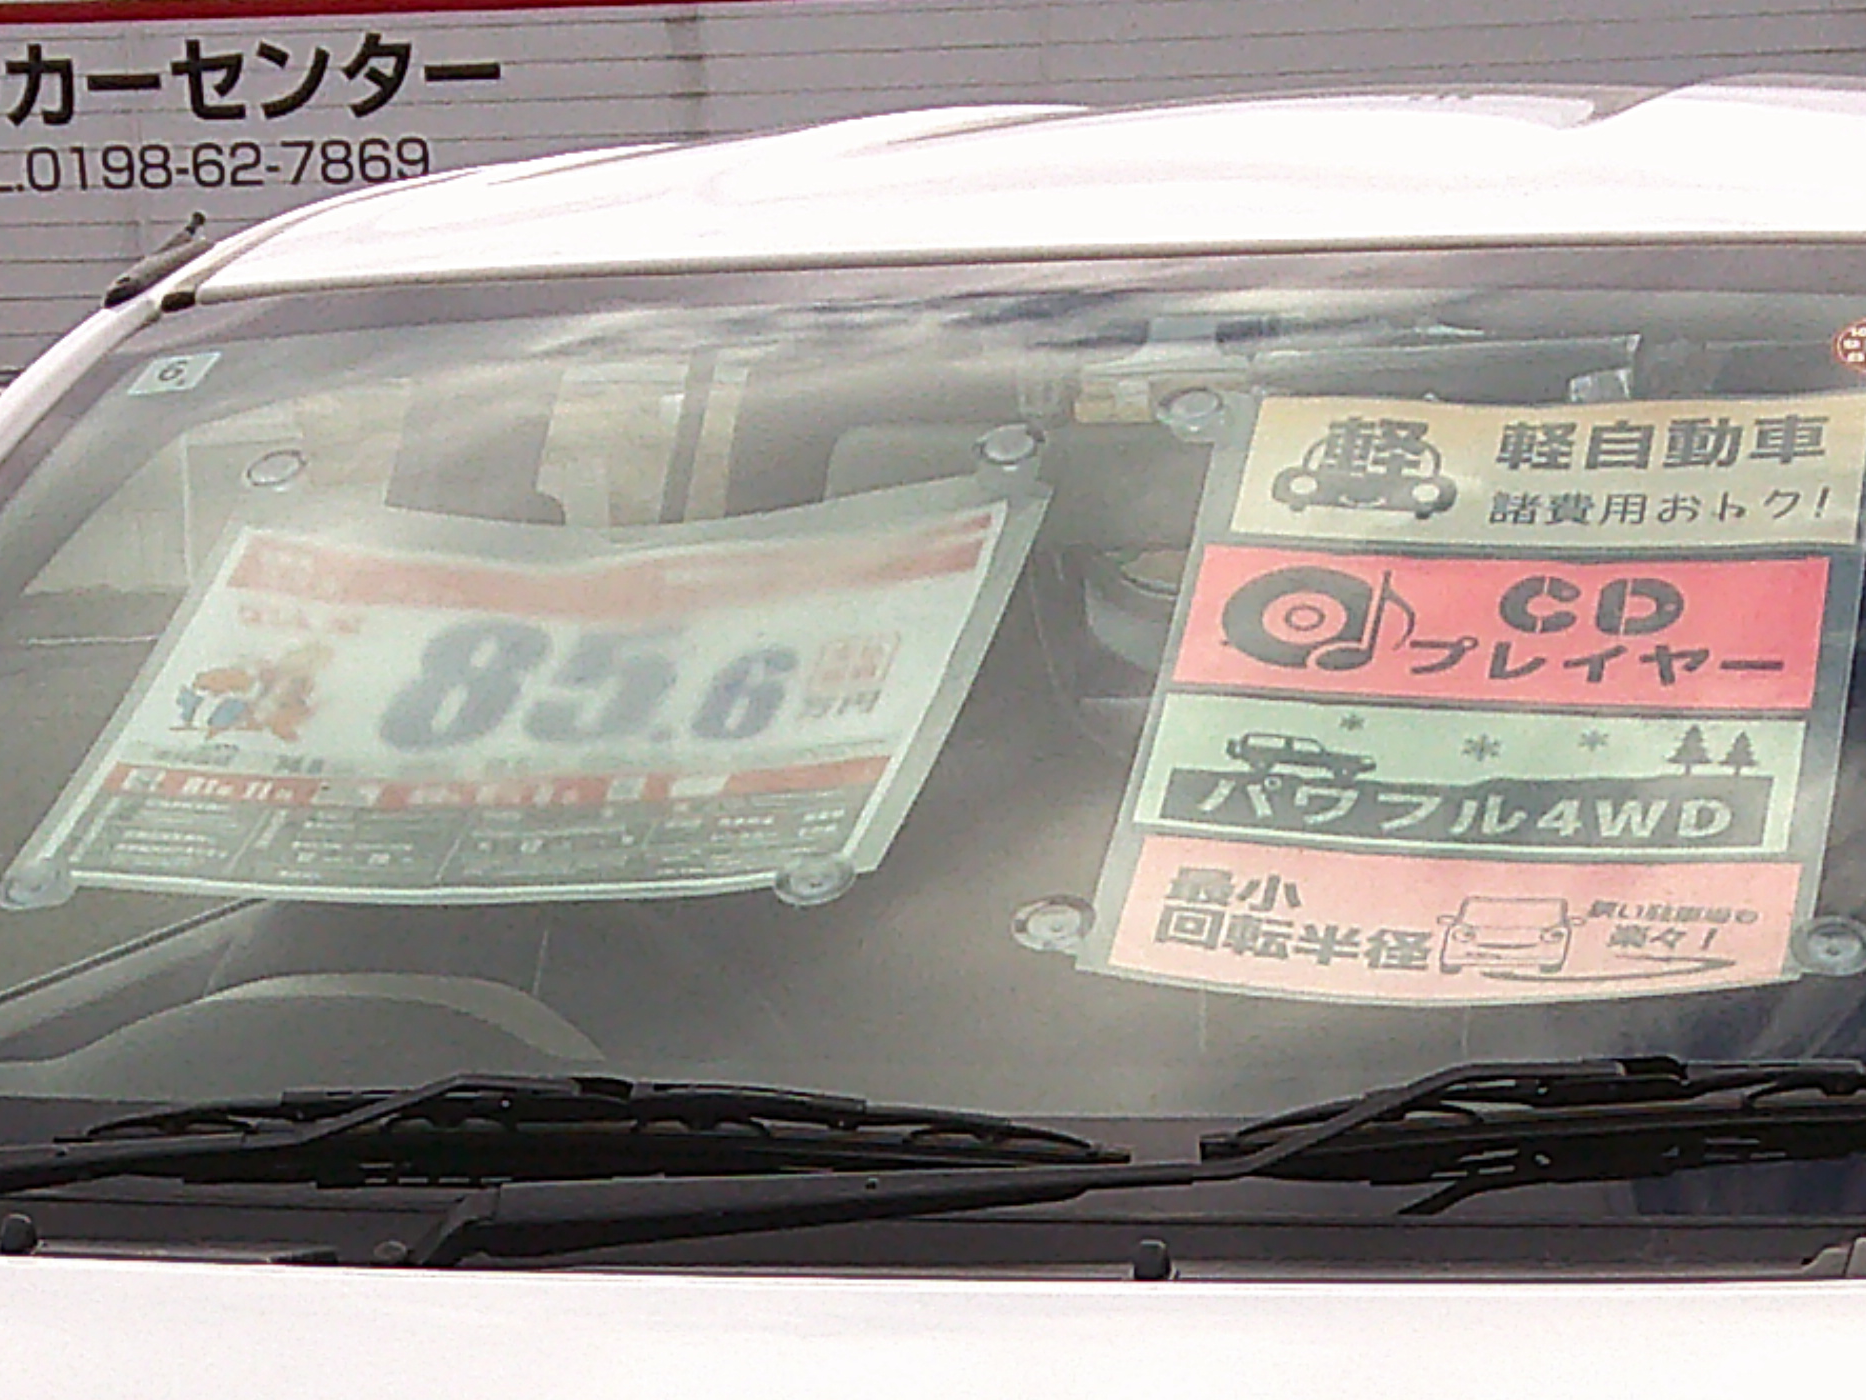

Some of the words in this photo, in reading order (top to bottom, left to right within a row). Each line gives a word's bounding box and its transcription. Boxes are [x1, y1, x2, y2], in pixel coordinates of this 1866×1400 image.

[1495, 413, 1831, 472] 軽自動車
[1499, 575, 1685, 636] CD
[1409, 636, 1786, 687] プレイヤー
[1199, 774, 1732, 839] パワフル4WD
[1164, 866, 1302, 911] 最小
[1154, 906, 1434, 971] 回転半径
